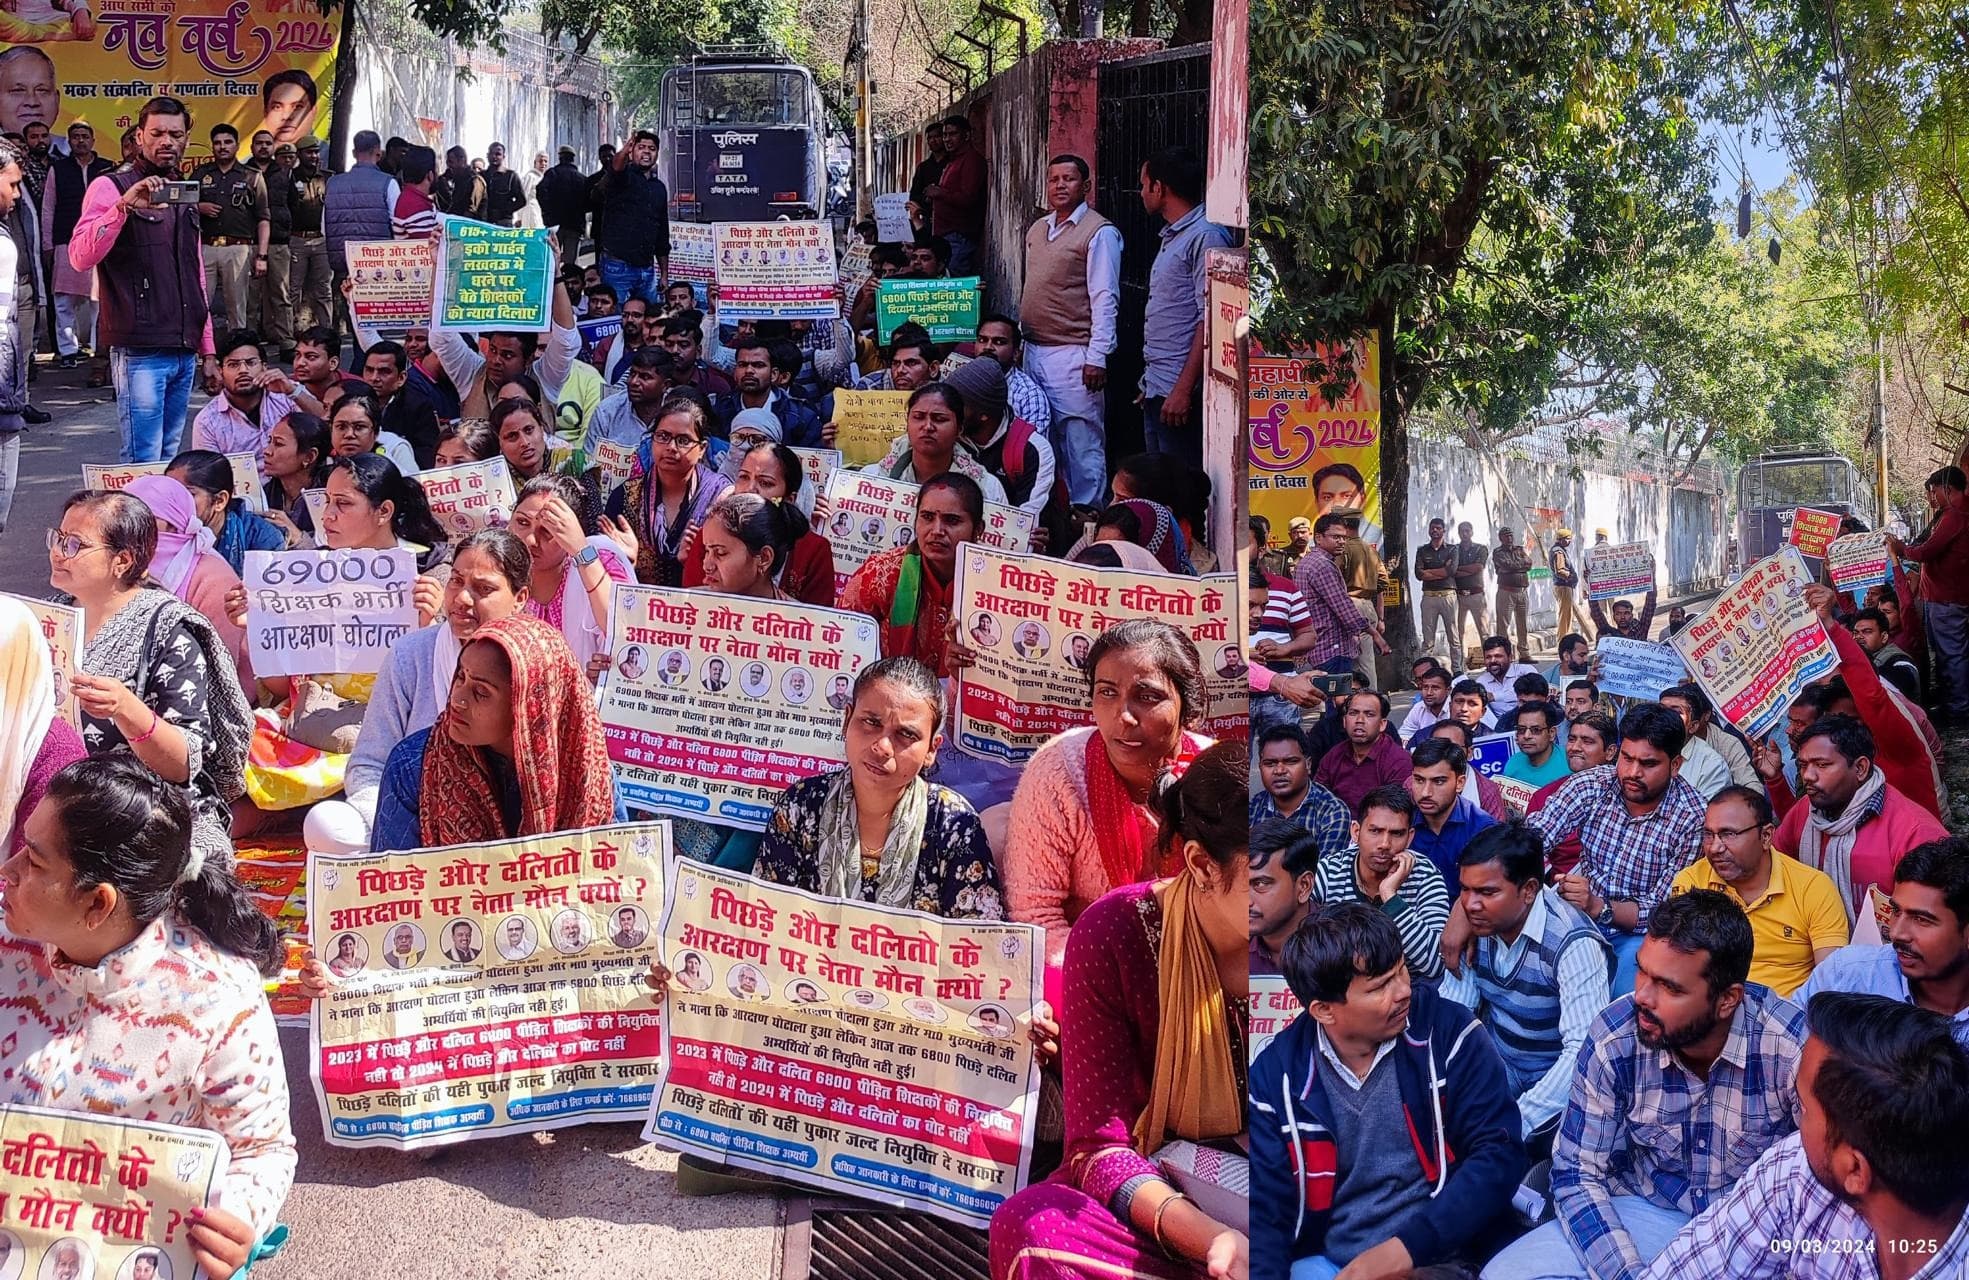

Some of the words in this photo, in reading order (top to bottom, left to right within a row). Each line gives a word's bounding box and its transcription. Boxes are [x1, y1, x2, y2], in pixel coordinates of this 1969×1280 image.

[97, 12, 170, 69] नव
[177, 0, 273, 77] वर्ष
[274, 20, 337, 53] 2024
[63, 84, 97, 97] मकर
[103, 80, 154, 97] संक्रान्ति
[158, 84, 171, 97] व
[224, 80, 259, 97] दिवस
[115, 116, 132, 128] की
[712, 131, 759, 148] पुलिस
[730, 227, 752, 239] पिछड़े
[756, 226, 773, 237] और
[808, 225, 819, 236] के
[463, 240, 491, 256] इको
[491, 240, 527, 255] गार्डन
[721, 240, 751, 249] आरक्षण
[754, 241, 764, 249] पर
[767, 240, 782, 249] नेता
[785, 239, 801, 248] मौन
[804, 237, 821, 248] क्यों
[824, 239, 829, 247] ?
[362, 246, 385, 260] पिछड़े
[389, 245, 406, 257] और
[387, 260, 398, 268] पर
[401, 258, 416, 267] नेता
[462, 259, 512, 271] लखनऊ
[471, 272, 497, 287] धरने
[499, 275, 517, 287] पर
[458, 288, 479, 304] बैठे
[480, 288, 527, 304] शिक्षकों
[882, 293, 906, 303] 6800
[907, 290, 930, 303] पिछड़े
[931, 290, 955, 301] दलित
[957, 289, 975, 300] और
[447, 304, 464, 320] को
[466, 306, 497, 320] न्याय
[497, 304, 539, 320] दिलाएं
[887, 304, 916, 314] दिव्यांग
[959, 301, 972, 311] को
[940, 313, 949, 323] दो
[596, 324, 621, 337] 6800
[1254, 387, 1269, 399] की
[1273, 388, 1294, 400] ओर
[1298, 389, 1308, 399] से
[1318, 419, 1377, 448] 2024
[808, 455, 820, 470] के
[423, 476, 461, 497] लितो
[465, 472, 482, 489] के
[1274, 474, 1308, 489] दिवस
[461, 490, 489, 509] क्यों
[495, 489, 502, 502] ?
[857, 480, 896, 506] पिछड़े
[836, 496, 888, 519] आरक्षण
[893, 507, 911, 524] पर
[1806, 513, 1828, 524] 69000
[990, 511, 1007, 529] के
[1010, 537, 1018, 550] ?
[1800, 533, 1826, 544] आरक्षण
[1799, 541, 1822, 554] घोटाला
[262, 555, 396, 585] 69000
[257, 589, 342, 614] शिक्षक
[353, 581, 407, 609] भर्ती
[999, 564, 1058, 602] पिछड़े
[1067, 578, 1112, 607] और
[1119, 584, 1196, 615] दलितो
[1200, 588, 1223, 613] के
[975, 591, 1051, 622] आरक्षण
[1058, 607, 1085, 630] पर
[1689, 616, 1719, 643] पिछड़े
[1717, 597, 1736, 620] और
[1734, 571, 1765, 598] दलितो
[1768, 561, 1781, 574] के
[648, 598, 699, 630] पिछड़े
[707, 606, 745, 631] और
[752, 612, 815, 642] दलितो
[821, 620, 844, 644] के
[1691, 631, 1725, 662] आरक्षण
[1723, 620, 1735, 634] पर
[1734, 604, 1751, 623] नेता
[1751, 588, 1766, 606] मौन
[1767, 572, 1787, 589] क्यों
[1791, 566, 1797, 575] ?
[41, 615, 57, 639] के
[261, 623, 336, 650] आरक्षण
[626, 626, 693, 650] आरक्षण
[699, 635, 721, 654] पर
[726, 635, 760, 659] नेता
[766, 640, 802, 665] मौन
[808, 647, 844, 670] क्यों
[850, 654, 862, 672] ?
[62, 650, 67, 668] ?
[967, 687, 994, 702] 2023
[1481, 761, 1502, 774] SC
[356, 864, 427, 896] पिछड़े
[439, 857, 490, 887] और
[499, 847, 581, 883] दलितो
[590, 841, 619, 871] के
[330, 896, 423, 931] आरक्षण
[431, 894, 462, 916] पर
[471, 888, 515, 915] नेता
[523, 880, 570, 909] मौन
[578, 874, 624, 904] क्यों
[636, 877, 647, 902] ?
[710, 886, 777, 938] पिछड़े
[788, 909, 841, 949] और
[848, 923, 940, 967] दलितो
[949, 937, 983, 968] के
[679, 922, 770, 966] आरक्षण
[778, 946, 808, 975] पर
[816, 952, 864, 989] नेता
[872, 965, 925, 997] मौन
[933, 973, 986, 1001] क्यों
[1000, 978, 1012, 1001] ?
[671, 1088, 703, 1114] पिछड़े
[708, 1096, 745, 1121] दलितों
[748, 1104, 768, 1127] की
[773, 1114, 799, 1133] यही
[804, 1122, 840, 1144] पुकार
[845, 1133, 878, 1154] जल्द
[884, 1138, 939, 1165] नियुक्ति
[941, 1150, 952, 1170] दे
[956, 1159, 1004, 1184] सरकार
[3, 1132, 107, 1185] दलितो
[118, 1146, 155, 1190] के
[19, 1186, 82, 1231] मौन
[92, 1199, 154, 1243] क्यों
[165, 1208, 182, 1243] ?
